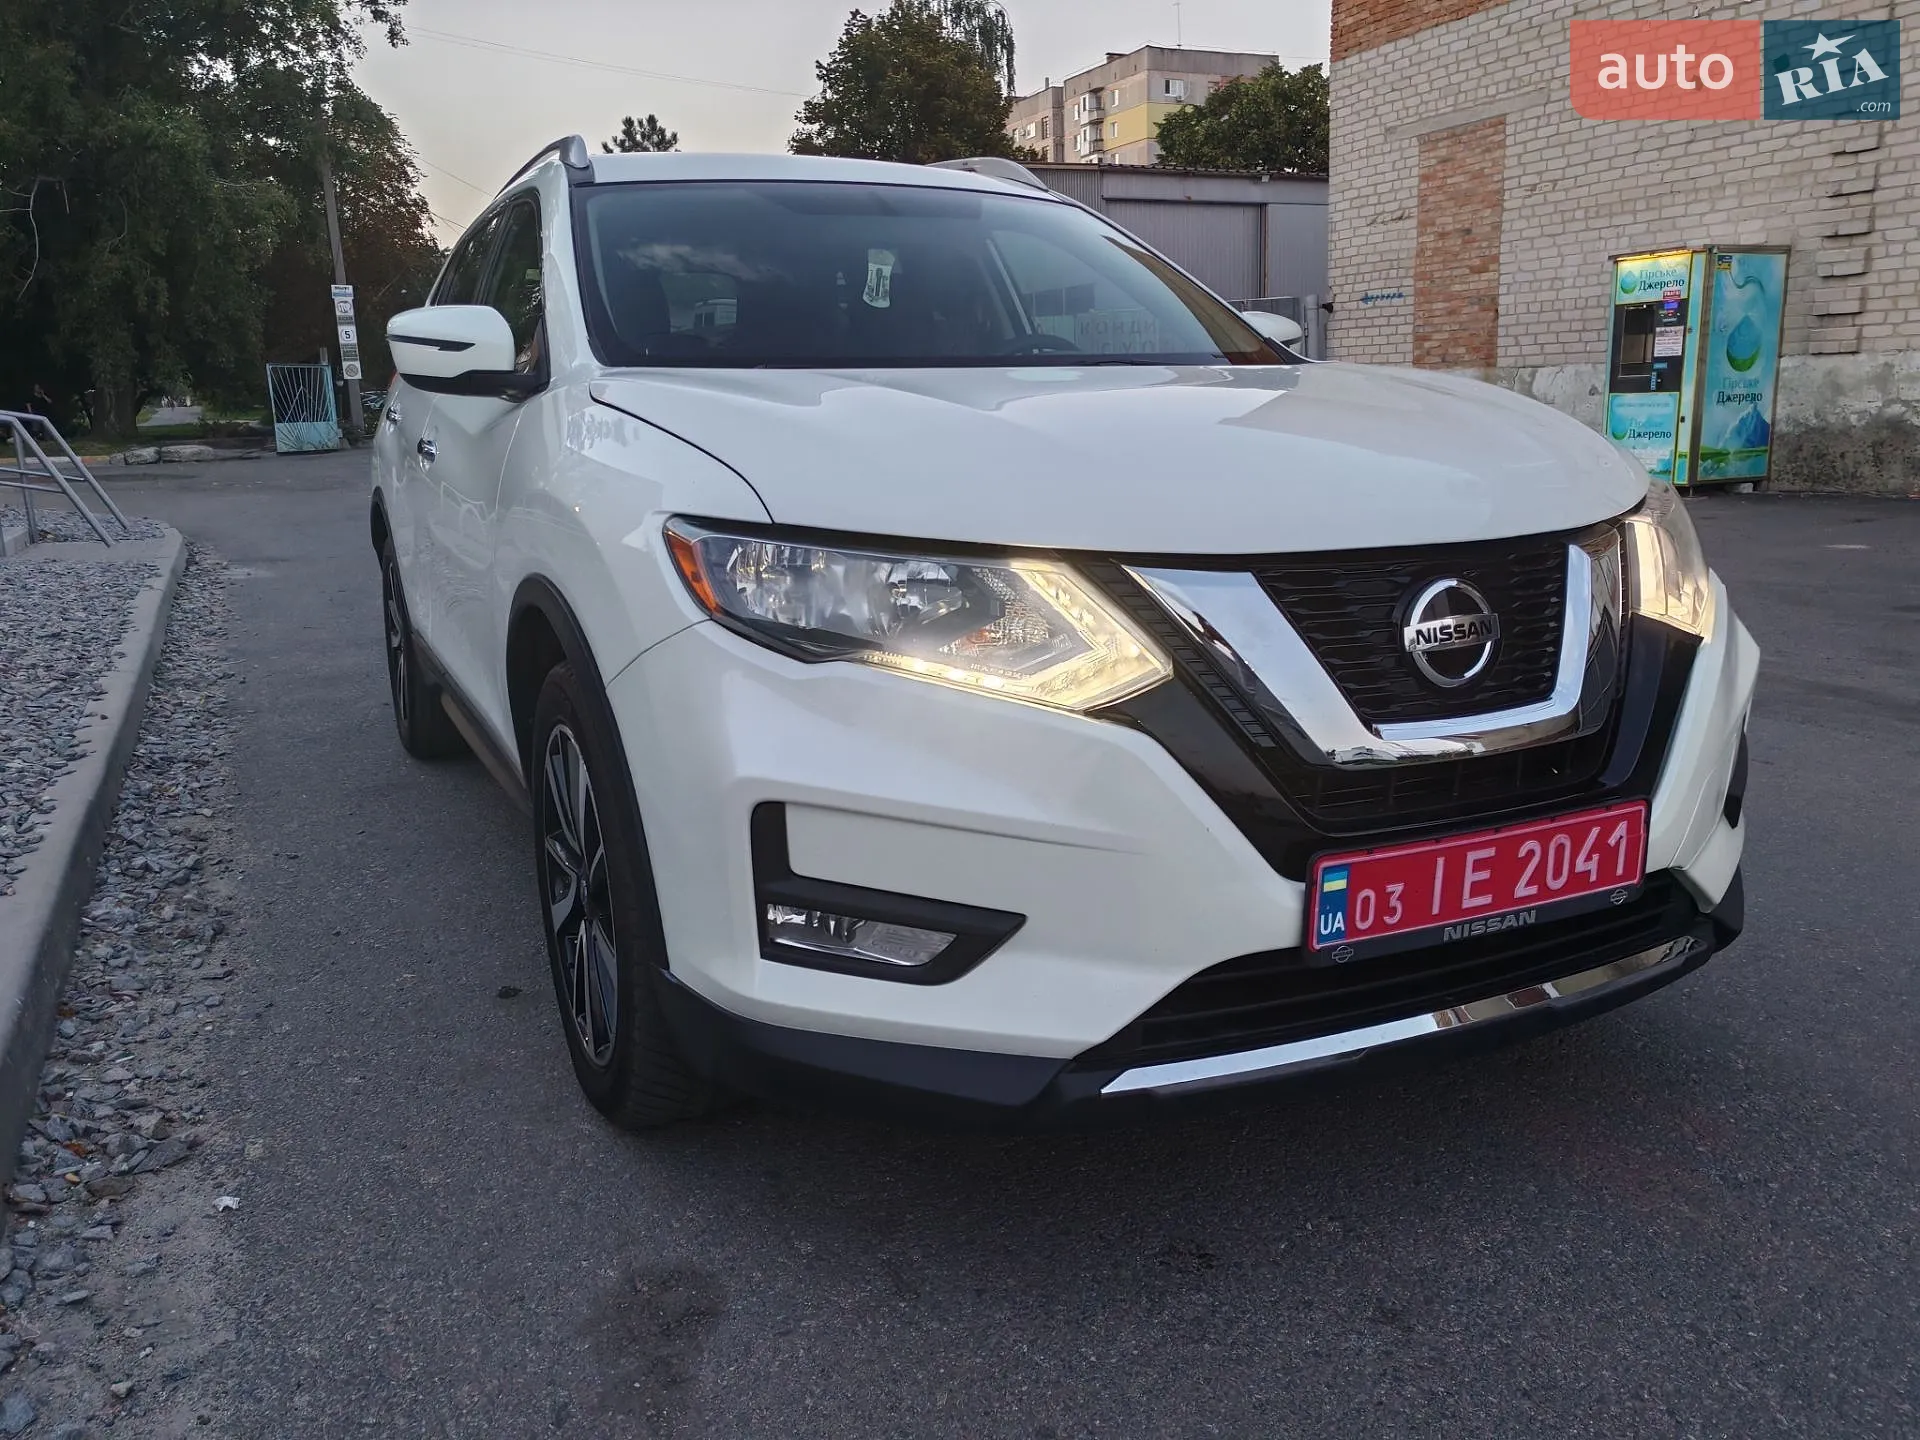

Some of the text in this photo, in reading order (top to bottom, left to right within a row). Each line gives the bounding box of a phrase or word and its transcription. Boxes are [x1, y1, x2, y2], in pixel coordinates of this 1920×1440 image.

[1639, 279, 1685, 291] Джерело
[1716, 391, 1763, 405] Джерело
[1628, 429, 1672, 440] Джерело
[1415, 620, 1492, 645] NISSAN
[1355, 882, 1405, 930] 03
[1513, 820, 1629, 899] 2041
[1320, 911, 1345, 935] UA
[1443, 909, 1536, 943] NISSAN
